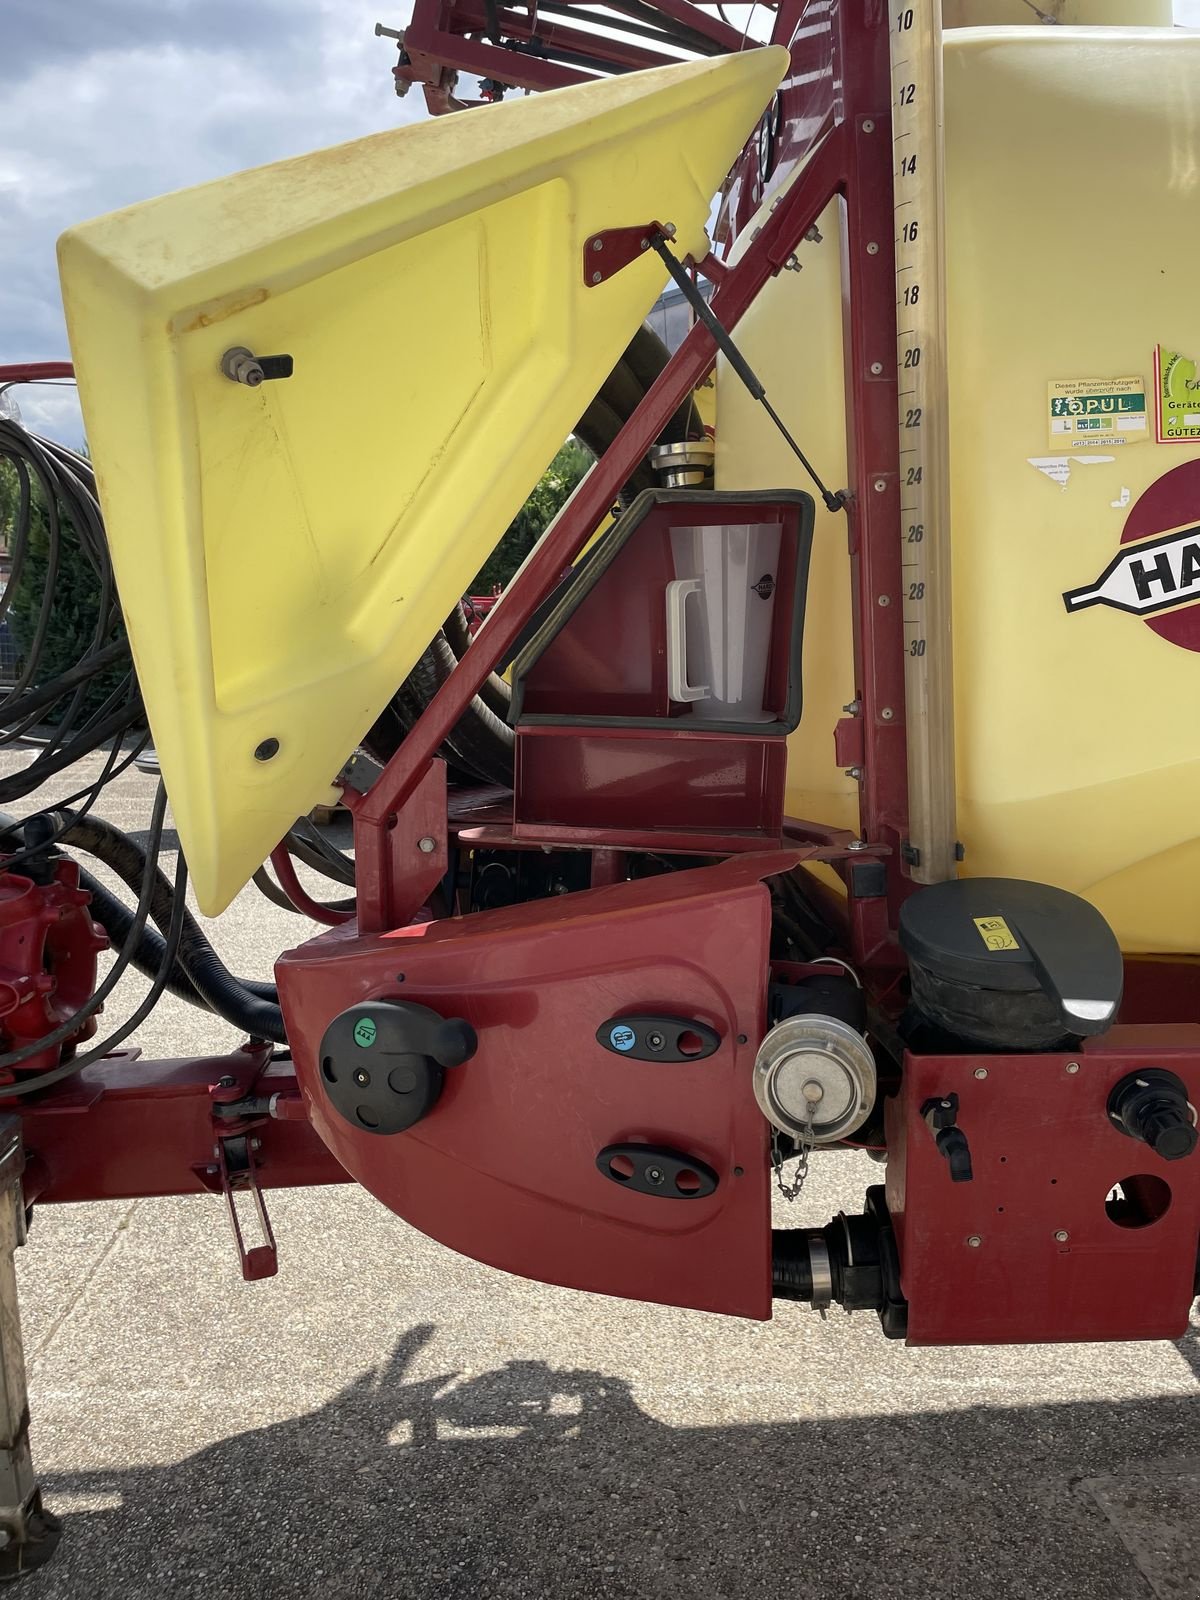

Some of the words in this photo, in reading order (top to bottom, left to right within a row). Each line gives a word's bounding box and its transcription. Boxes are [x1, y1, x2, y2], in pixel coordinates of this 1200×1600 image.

[898, 10, 914, 33] 10
[900, 84, 916, 107] 12
[901, 155, 917, 177] 14
[903, 222, 919, 244] 16
[904, 285, 920, 307] 18
[905, 348, 921, 369] 20
[1078, 379, 1140, 387] Pflanzenschutzgerät
[906, 409, 922, 429] 22
[907, 467, 923, 486] 24
[908, 525, 924, 543] 26
[909, 583, 925, 601] 28
[910, 640, 926, 657] 30
